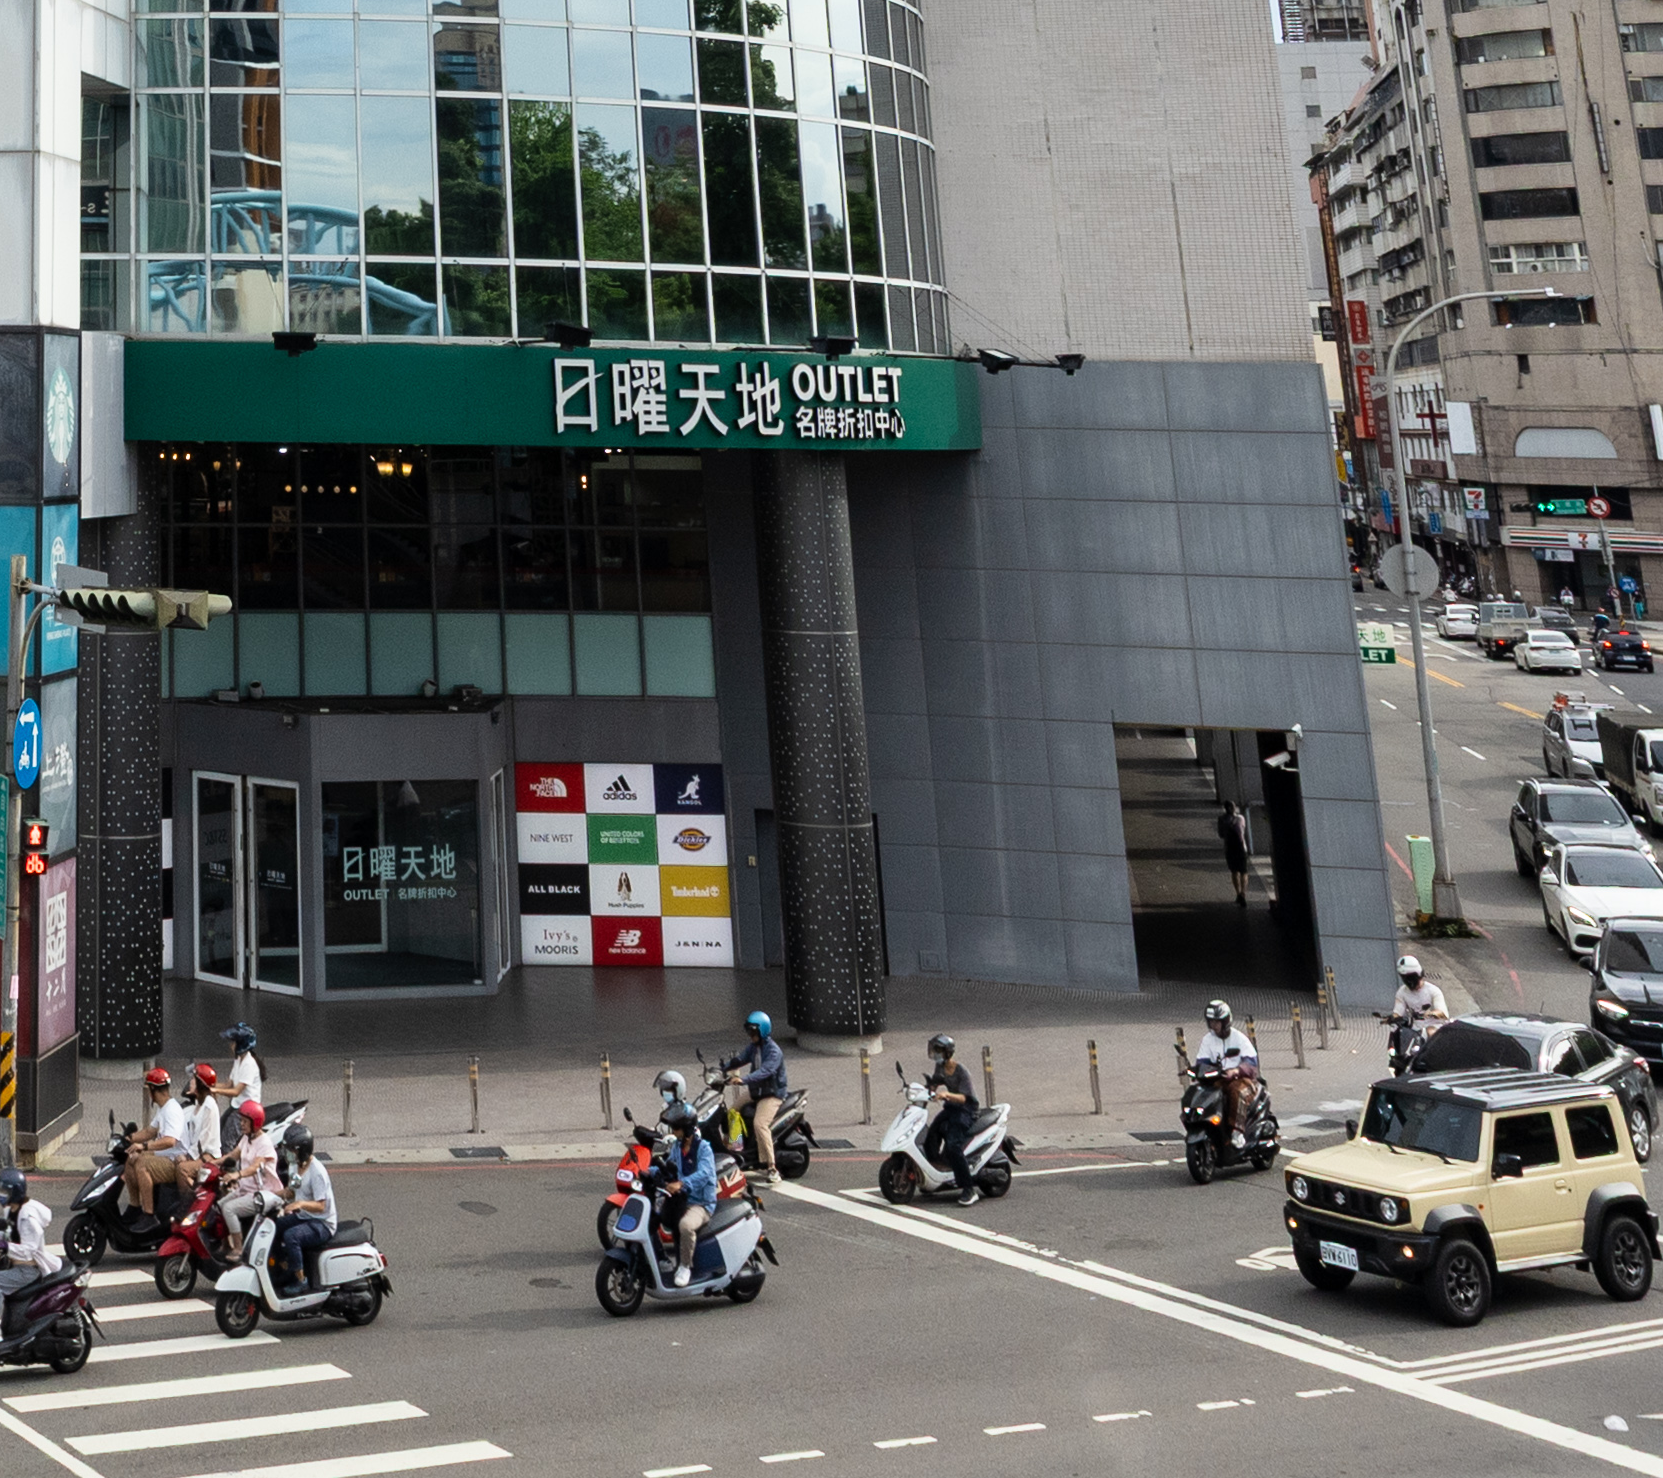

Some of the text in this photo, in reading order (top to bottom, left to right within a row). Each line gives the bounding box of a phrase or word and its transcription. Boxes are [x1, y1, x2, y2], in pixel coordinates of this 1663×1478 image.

[552, 357, 904, 437] 日曜天地 OUTLET
[795, 405, 906, 440] 名牌折扣中心
[603, 790, 637, 801] adidas
[530, 833, 574, 843] NINE WEST
[676, 836, 709, 845] Dickies
[342, 844, 458, 883] 日曜天地
[343, 886, 458, 902] OUTLET 名牌折扣中心
[528, 885, 581, 894] ALL BLACK
[671, 886, 710, 898] Timberland
[543, 928, 571, 943] Ivy's
[534, 945, 579, 955] MOORIS
[625, 947, 647, 955] balance
